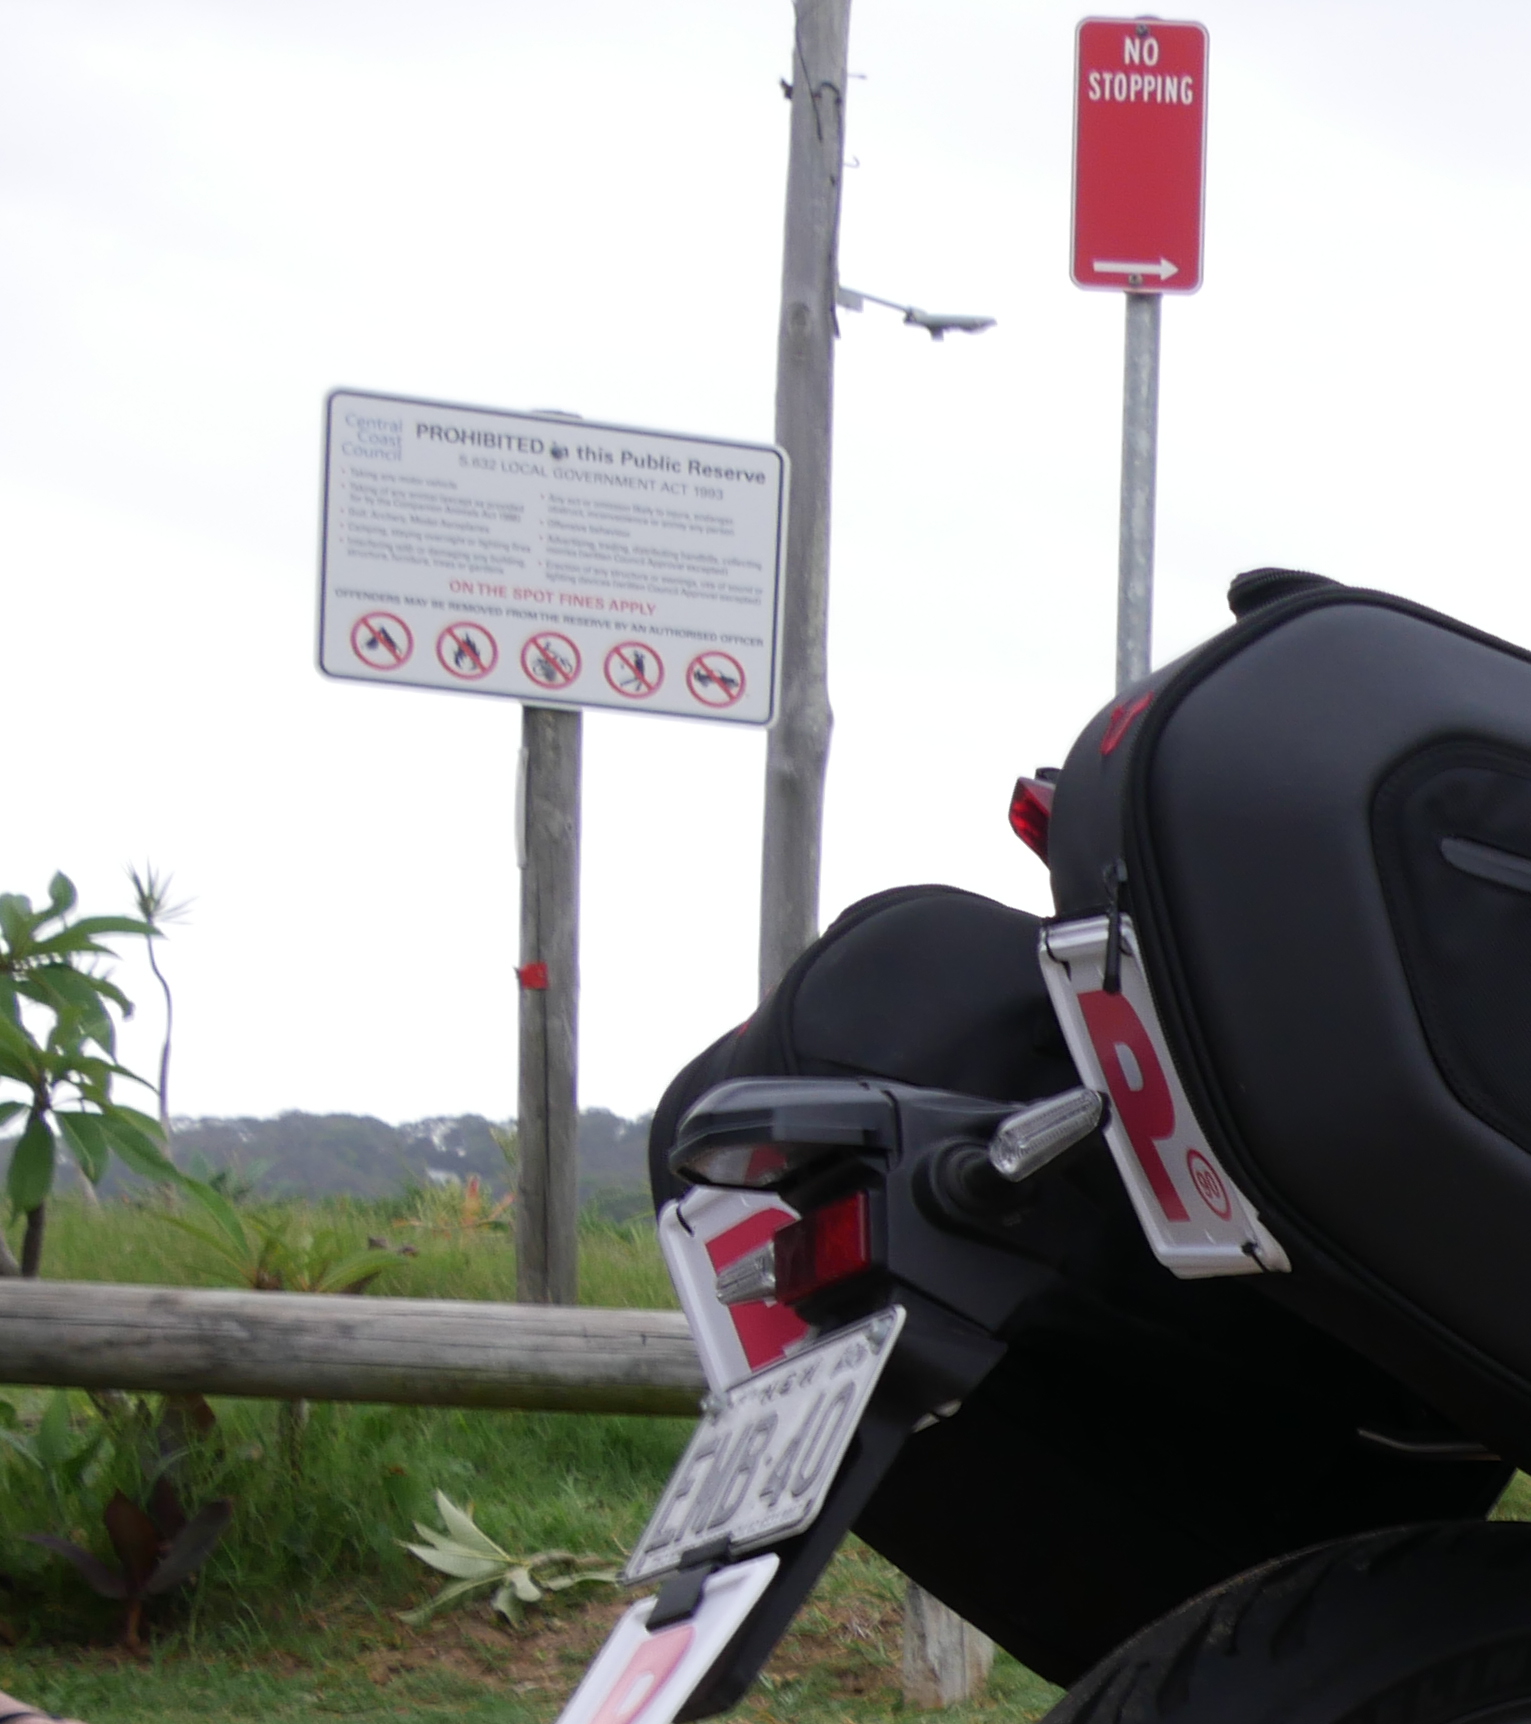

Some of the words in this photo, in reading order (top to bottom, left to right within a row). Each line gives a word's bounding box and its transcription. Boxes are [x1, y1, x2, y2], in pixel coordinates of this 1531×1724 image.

[1123, 36, 1159, 66] NO
[1088, 70, 1193, 105] STOPPING
[345, 413, 402, 431] Central
[357, 430, 402, 447] Coast
[342, 442, 402, 461] Council
[416, 422, 544, 454] PROHIBITED
[551, 440, 569, 461] n
[577, 444, 613, 465] this
[621, 450, 681, 474] Public
[688, 459, 766, 485] Reserve
[501, 459, 547, 477] LOCAL
[553, 467, 656, 490] GOVERNMENT
[661, 482, 687, 496] ACT
[694, 486, 724, 500] 1993
[449, 579, 474, 595] ON
[478, 583, 507, 598] THE
[513, 588, 554, 604] SPOT
[559, 592, 604, 611] FINES
[609, 599, 657, 616] APPLY
[335, 588, 400, 605] OFFENDERS
[403, 597, 428, 608] MAY
[431, 600, 445, 610] BE
[448, 602, 503, 617] REMOVED
[505, 608, 538, 621] FROM
[539, 612, 560, 623] THE
[562, 615, 612, 630] RESERVE
[614, 621, 628, 632] BY
[631, 624, 648, 635] AN
[649, 626, 718, 642] AUTHORISED
[720, 634, 764, 647] OFFICER
[1077, 989, 1191, 1222] P
[1196, 1170, 1221, 1199] 90
